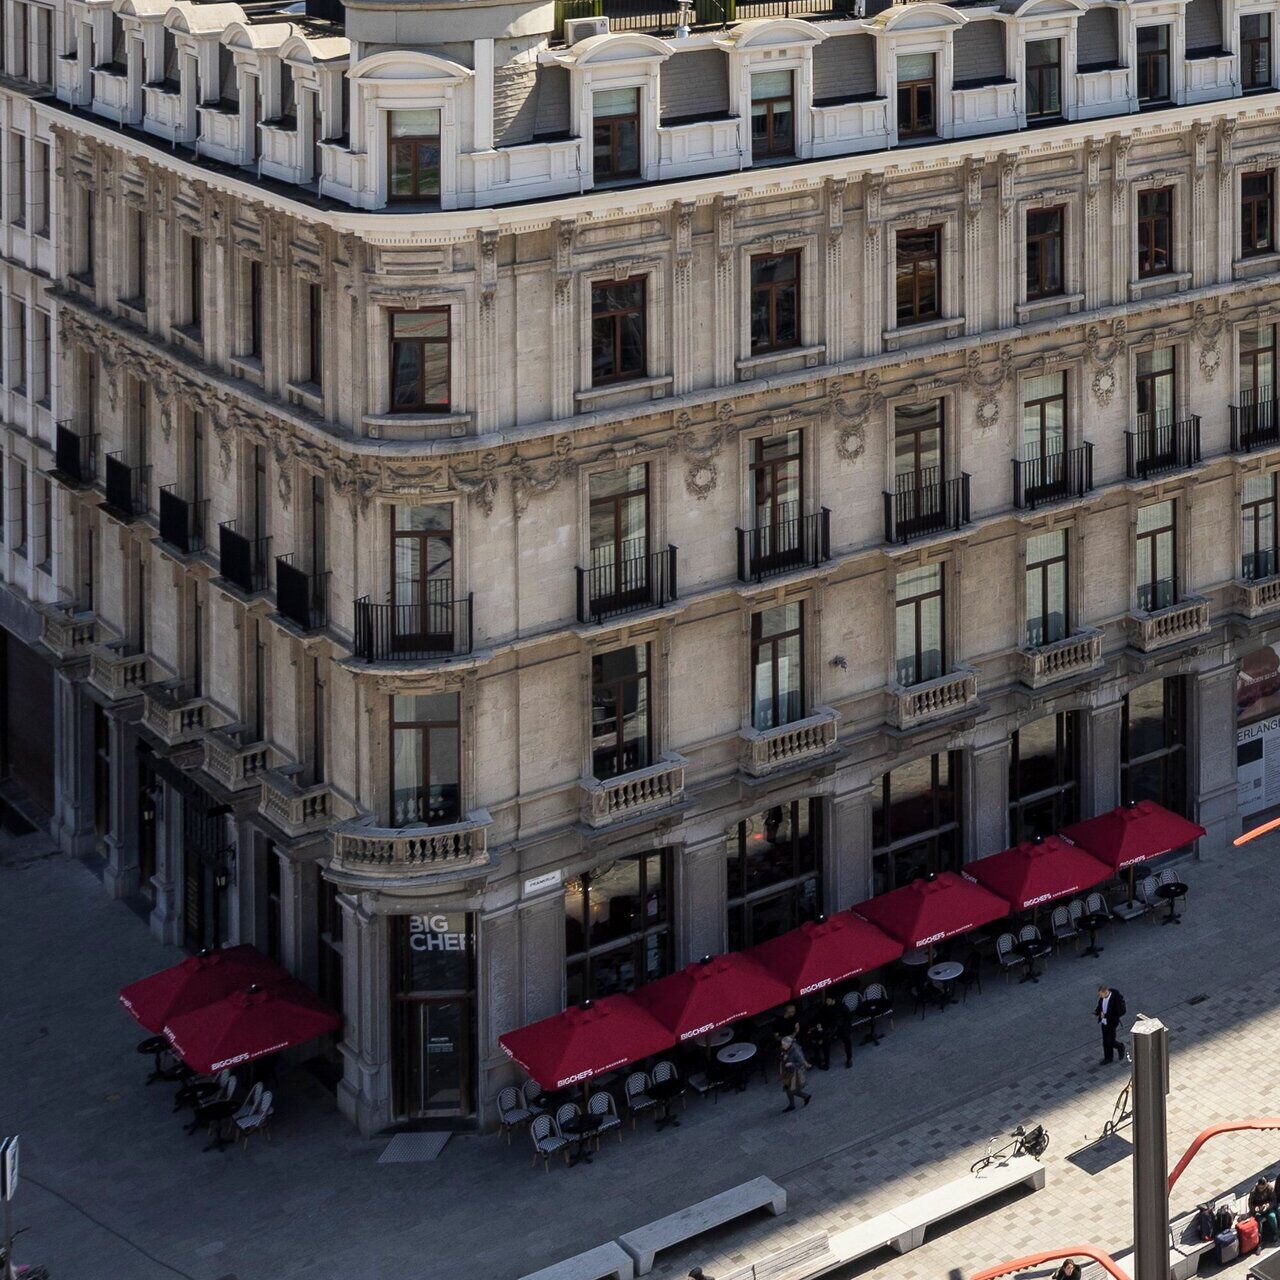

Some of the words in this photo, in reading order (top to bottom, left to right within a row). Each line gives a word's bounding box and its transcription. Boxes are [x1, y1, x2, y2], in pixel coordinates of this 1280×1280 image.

[410, 915, 449, 933] BIG
[680, 1022, 714, 1041] BIGCHEFS
[211, 1052, 250, 1071] BIGCHEFS
[557, 1068, 594, 1088] BIGCHEFS
